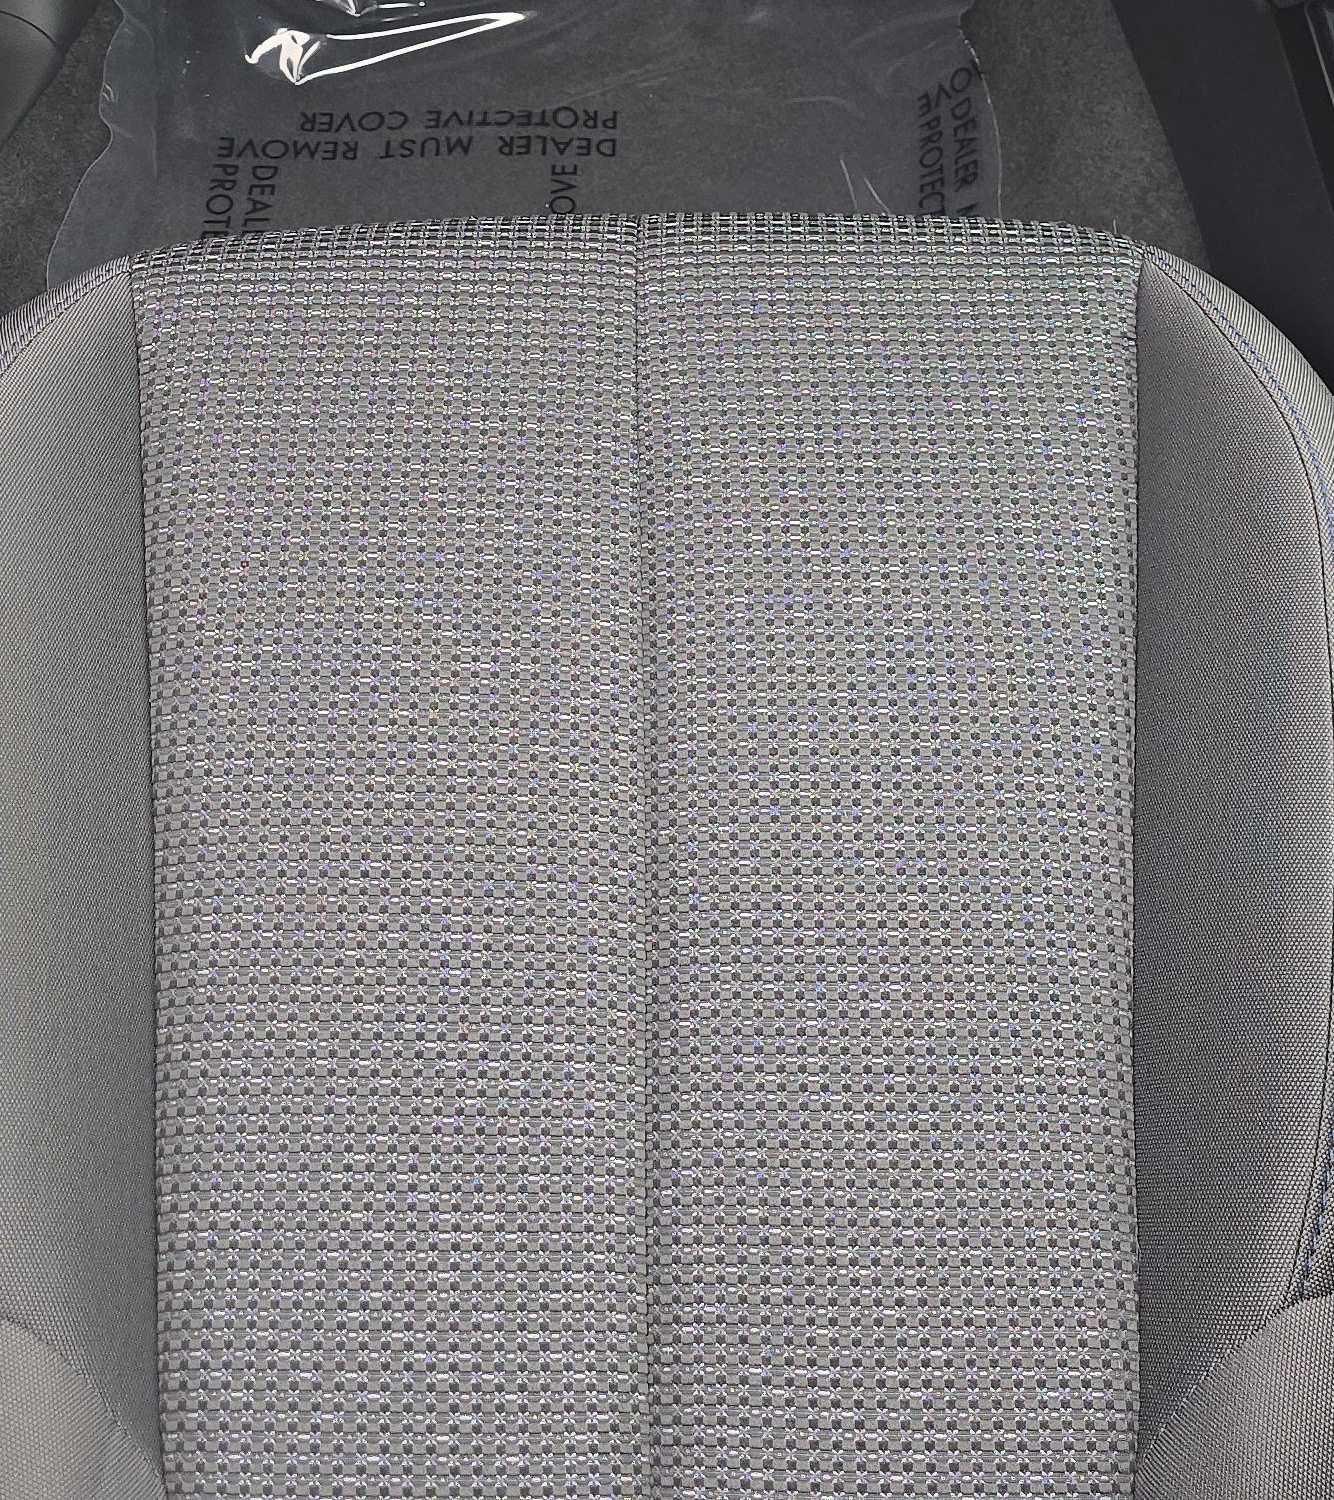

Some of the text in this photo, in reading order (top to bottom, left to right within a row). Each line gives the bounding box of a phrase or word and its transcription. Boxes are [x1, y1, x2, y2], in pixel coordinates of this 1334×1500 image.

[300, 105, 618, 133] PROTECTIVE COVER
[217, 135, 618, 161] DEALER MUST REMOVE
[950, 97, 979, 193] DEALER
